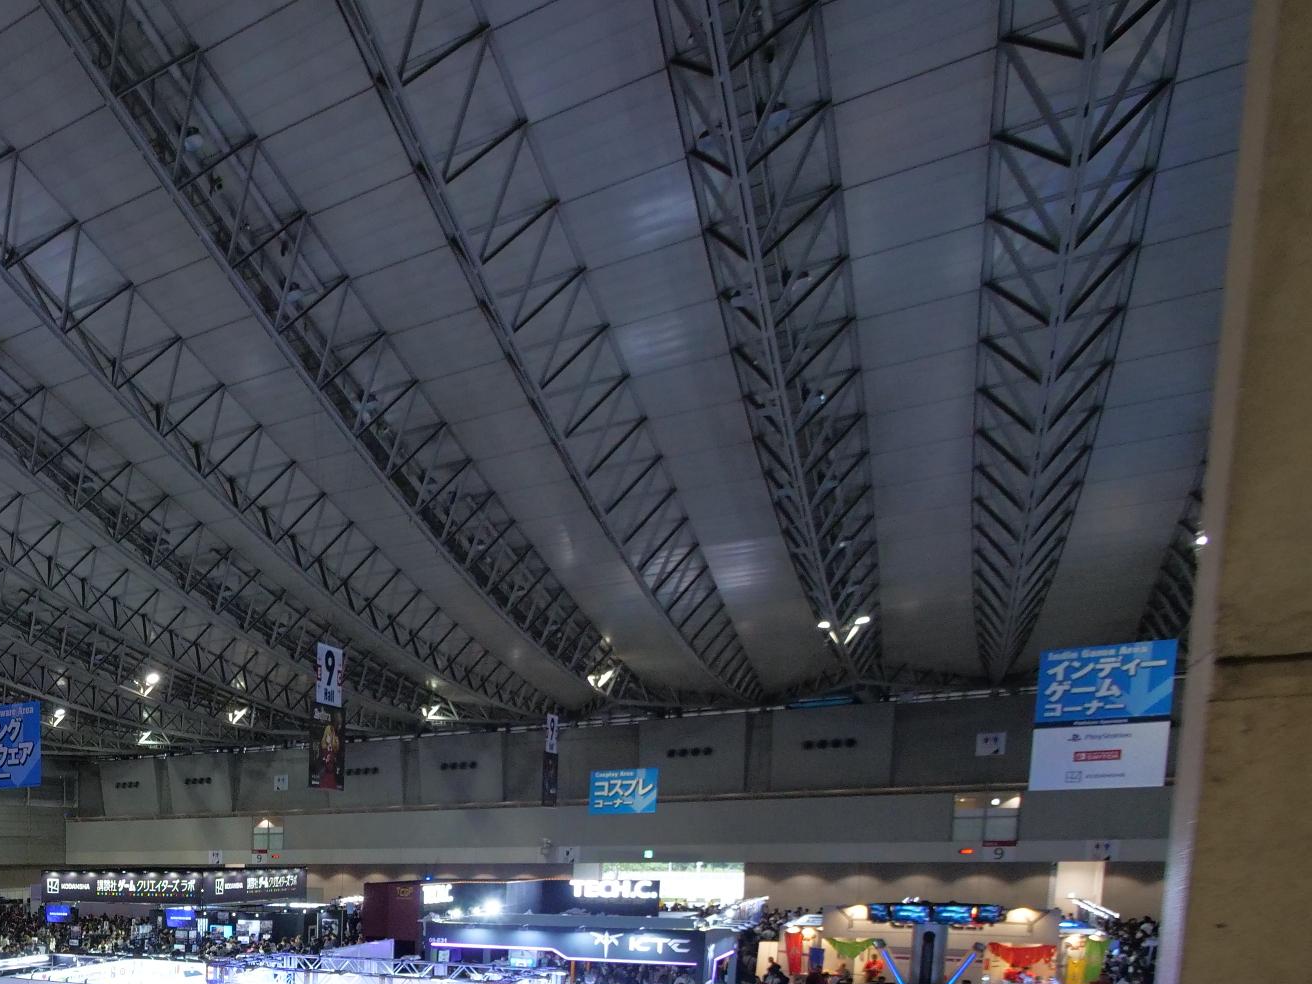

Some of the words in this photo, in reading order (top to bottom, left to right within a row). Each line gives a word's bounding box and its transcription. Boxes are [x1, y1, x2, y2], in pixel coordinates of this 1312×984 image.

[324, 650, 336, 686] 9
[1046, 656, 1167, 681] インディー
[1044, 678, 1121, 702] ゲーム
[19, 706, 34, 716] Area
[1043, 700, 1125, 717] コーナー
[549, 717, 555, 741] 9
[594, 777, 654, 797] コスプレ
[594, 799, 633, 808] コーナー
[993, 847, 1004, 860] 9
[628, 936, 691, 955] KTC
